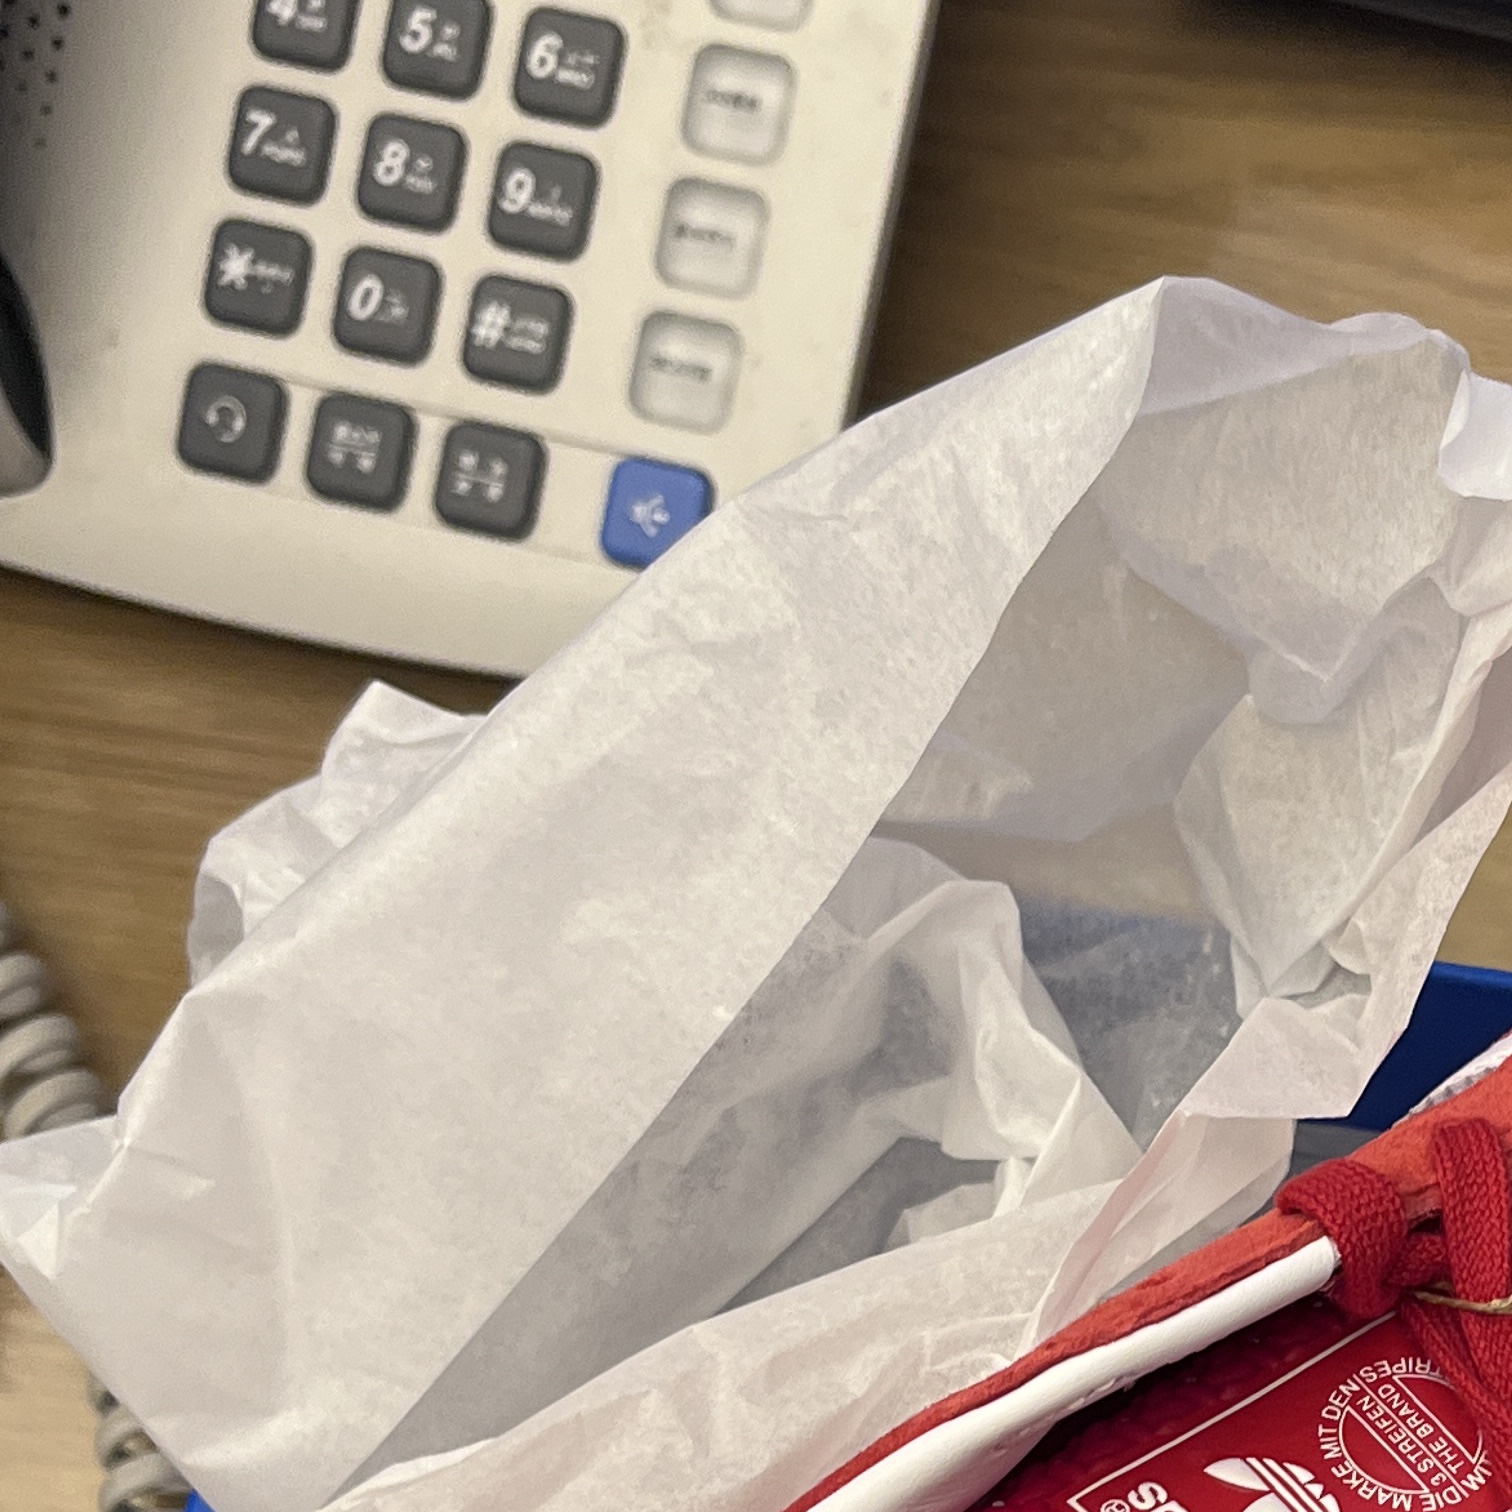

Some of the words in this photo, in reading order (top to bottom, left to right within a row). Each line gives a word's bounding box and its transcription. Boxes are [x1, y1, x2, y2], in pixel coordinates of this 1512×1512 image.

[400, 5, 437, 53] 5
[525, 32, 563, 80] 6
[241, 110, 276, 156] 7
[373, 138, 410, 186] 8
[498, 167, 536, 213] 9
[347, 274, 384, 321] 0
[1321, 1379, 1361, 1421] DEN
[1377, 1384, 1435, 1438] BRAND
[1318, 1424, 1343, 1460] MIT
[1356, 1395, 1434, 1473] STREIFEN
[1428, 1436, 1465, 1475] THE
[1331, 1459, 1413, 1512] MARKE
[1419, 1486, 1463, 1512] DIE
[1430, 1473, 1448, 1486] 3
